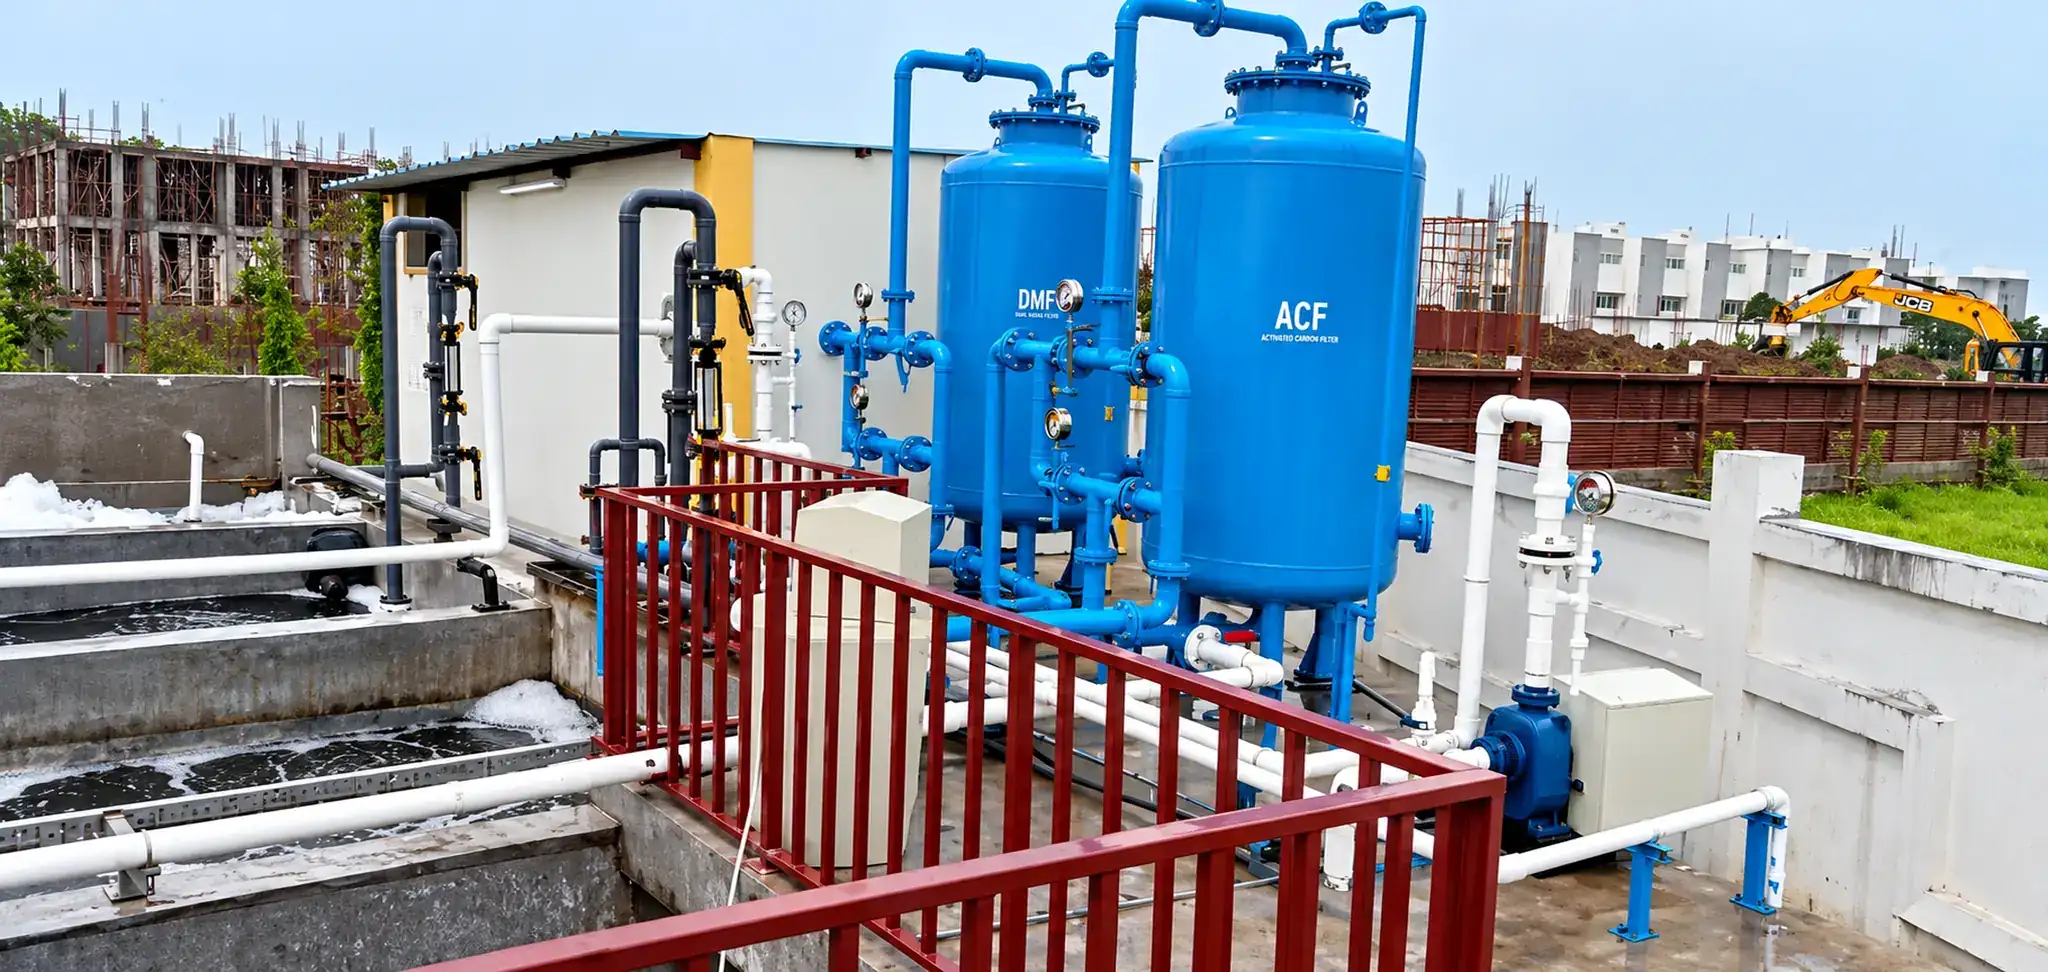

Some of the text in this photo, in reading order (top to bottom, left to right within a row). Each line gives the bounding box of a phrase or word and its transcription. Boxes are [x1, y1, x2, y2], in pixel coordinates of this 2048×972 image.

[1018, 289, 1056, 310] DMF
[1894, 294, 1932, 312] JCB
[1275, 301, 1328, 331] ACF
